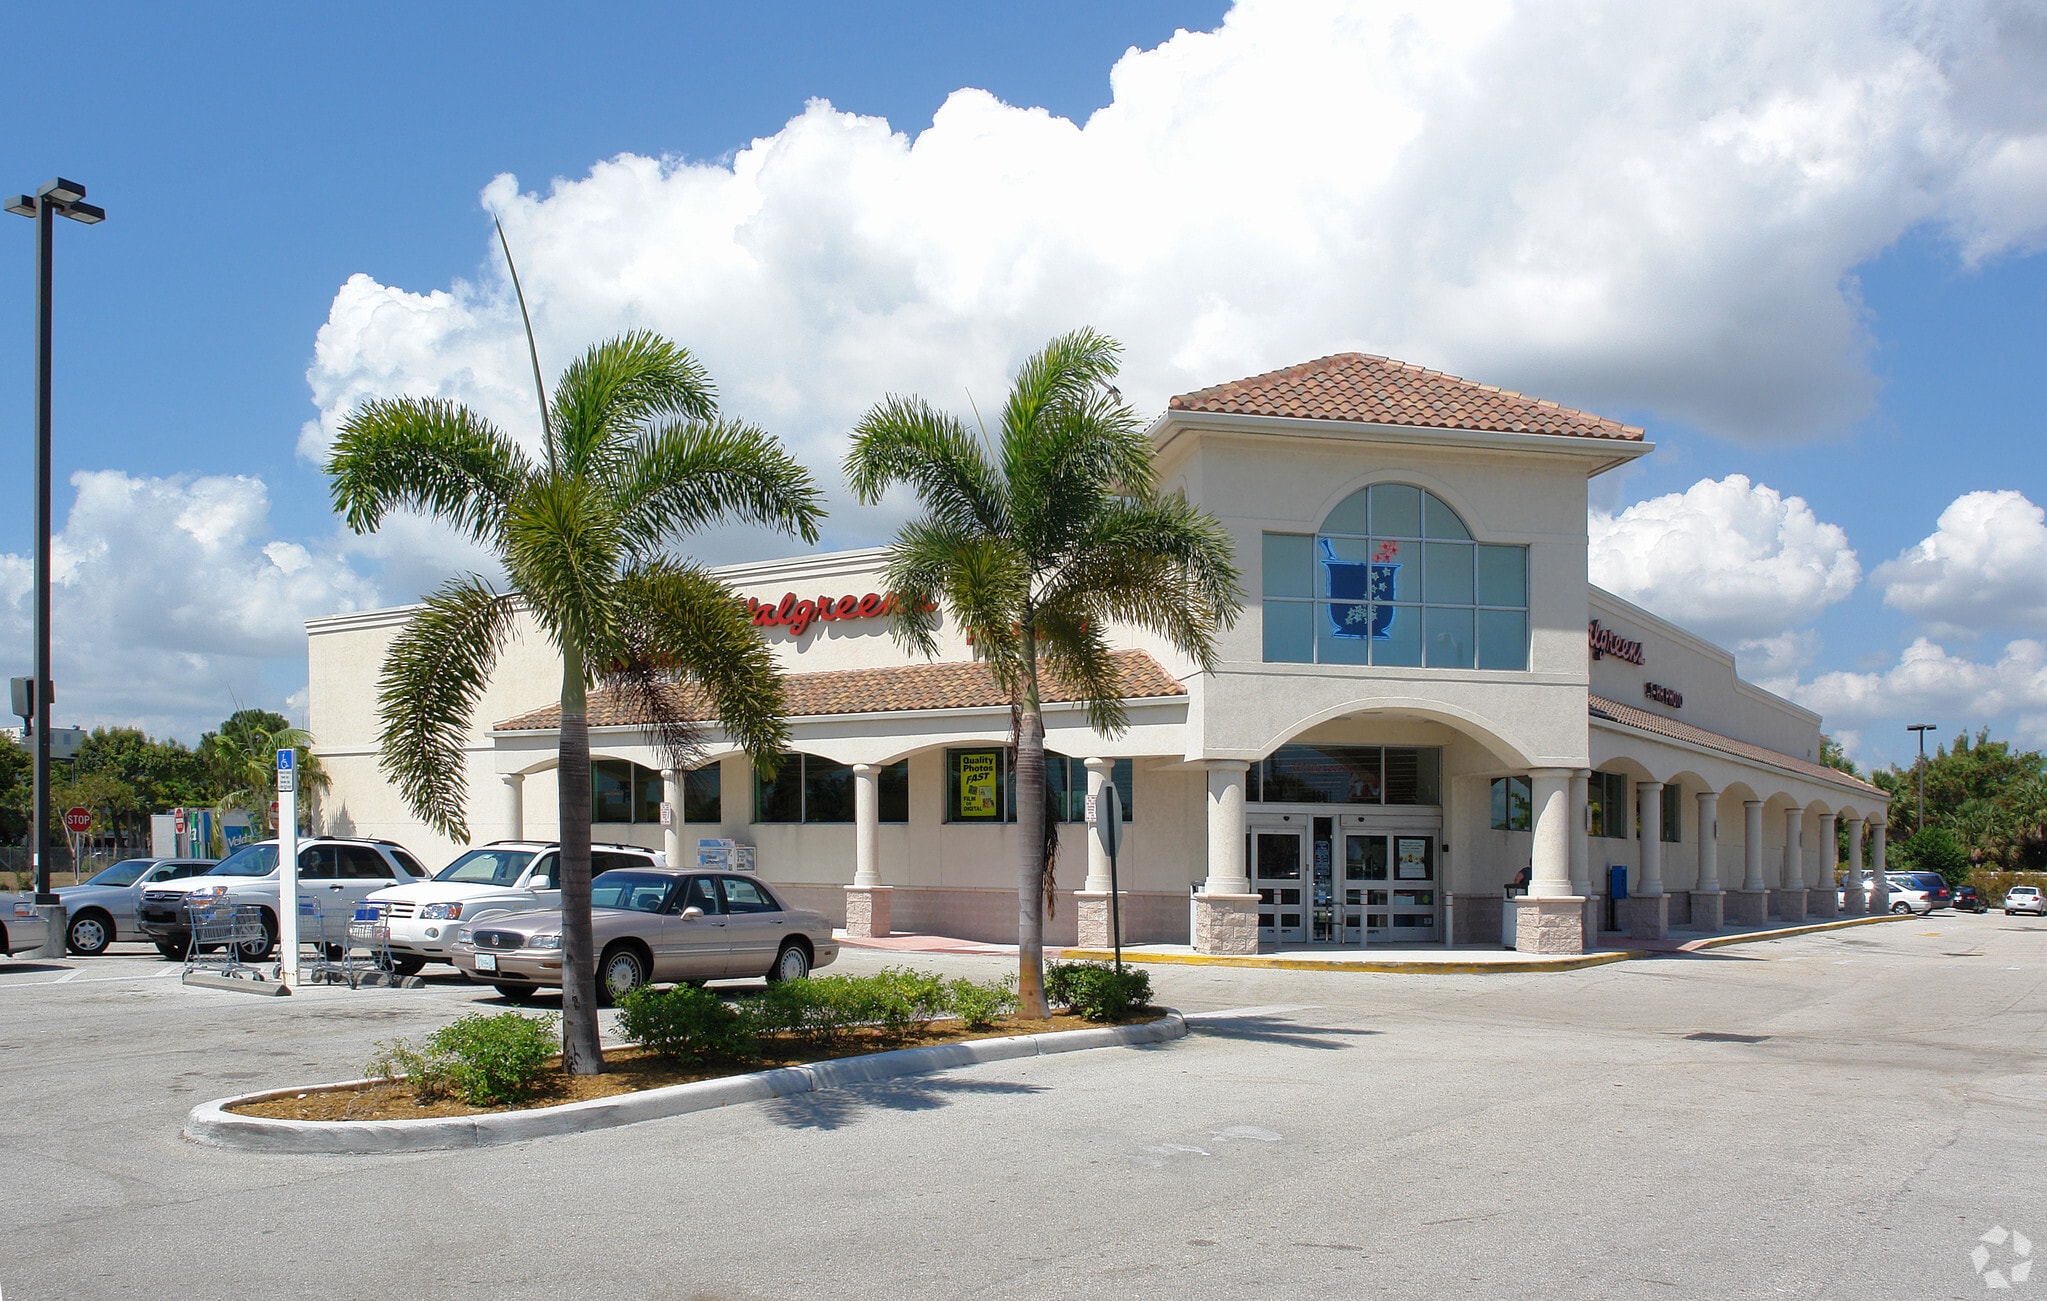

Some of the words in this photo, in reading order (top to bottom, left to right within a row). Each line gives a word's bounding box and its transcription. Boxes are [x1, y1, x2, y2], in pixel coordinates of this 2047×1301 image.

[737, 592, 939, 636] algreen
[963, 756, 994, 765] Quality
[966, 772, 990, 785] FAST
[67, 815, 91, 825] STOP
